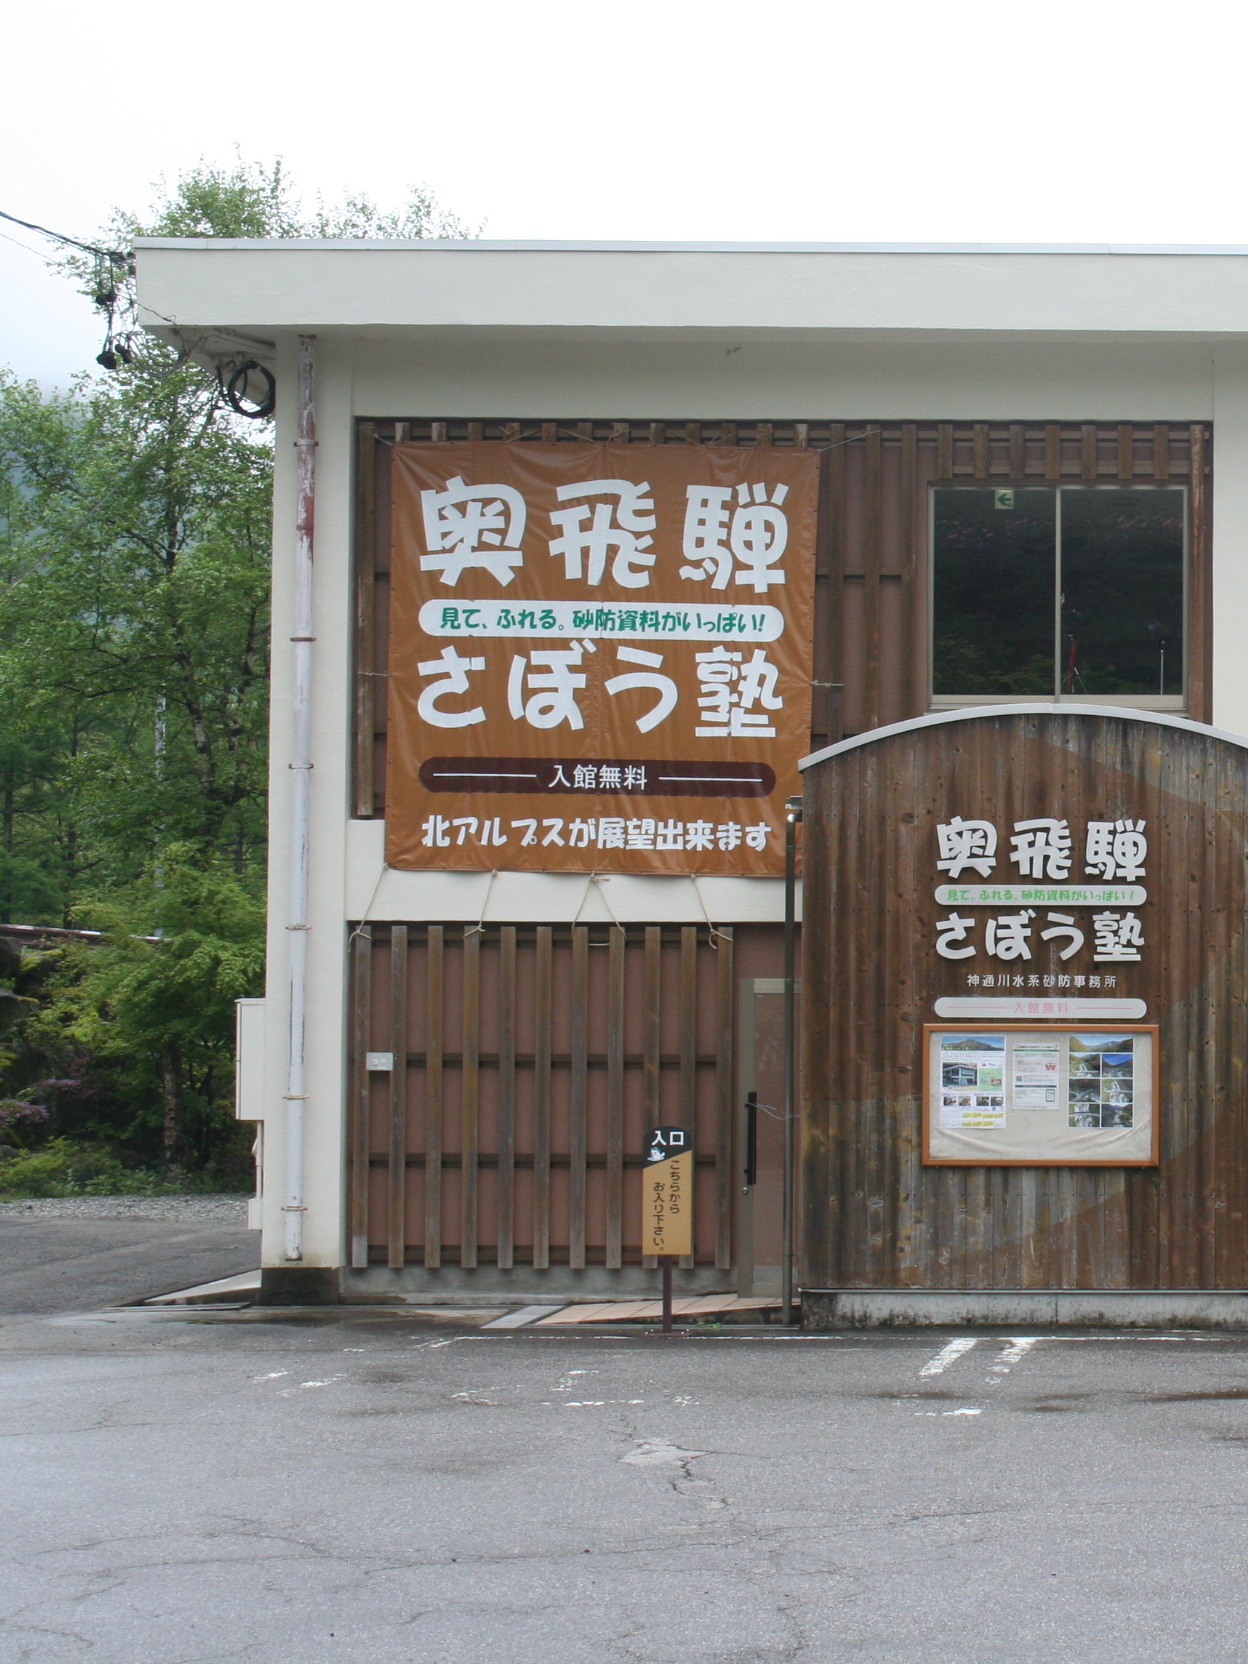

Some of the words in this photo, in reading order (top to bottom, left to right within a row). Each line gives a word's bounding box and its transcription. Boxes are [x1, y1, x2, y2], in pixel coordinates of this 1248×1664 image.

[419, 475, 789, 593] 奥飛騨
[417, 639, 783, 738] さぼう塾
[548, 764, 648, 790] 入館無料
[421, 815, 772, 852] 北アルプスが展望出来ます
[936, 816, 1148, 882] 奥飛騨
[935, 908, 1145, 961] さぼう塾
[966, 974, 1117, 989] 神通川水系砂防事務所
[1013, 1002, 1069, 1014] 入館無料
[651, 1130, 685, 1146] 入口
[669, 1160, 681, 1214] こちらから
[653, 1181, 665, 1251] お入り下さい。
